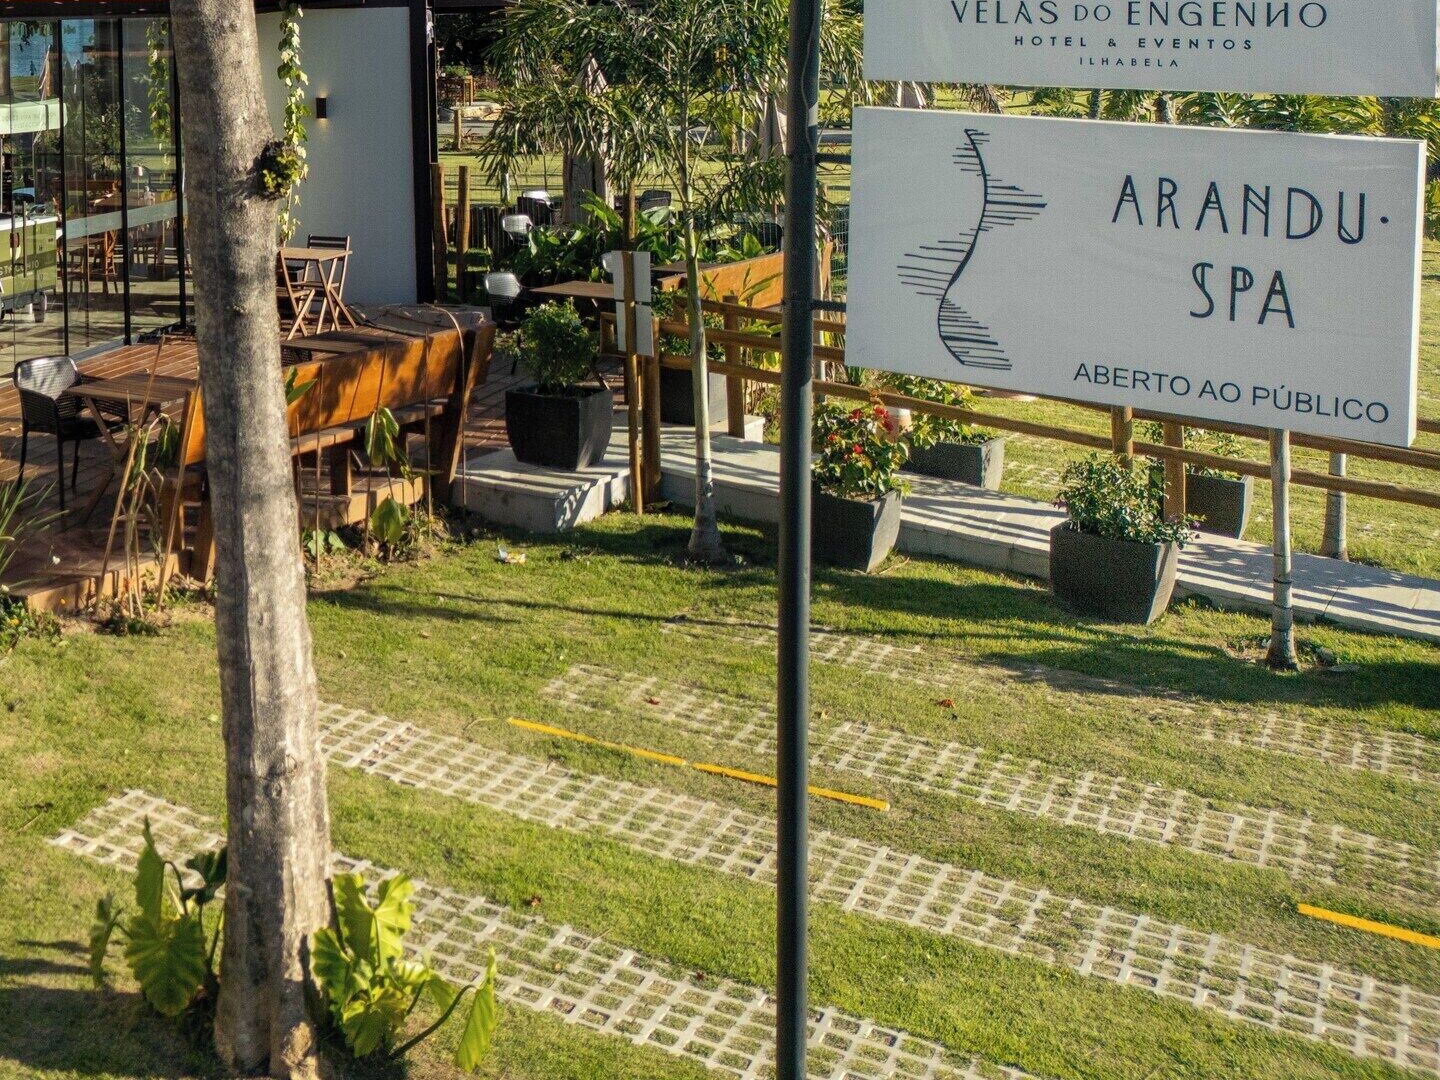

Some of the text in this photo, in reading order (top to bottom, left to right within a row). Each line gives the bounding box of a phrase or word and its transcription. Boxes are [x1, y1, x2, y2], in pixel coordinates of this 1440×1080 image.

[950, 0, 1059, 25] VELAS
[1074, 4, 1112, 22] DO
[1014, 35, 1253, 51] HOTEL & EVENTOS
[1078, 56, 1179, 68] ILHABELA
[1189, 262, 1295, 329] SPA
[1073, 362, 1389, 424] ABERTO AO PÚBLICO
